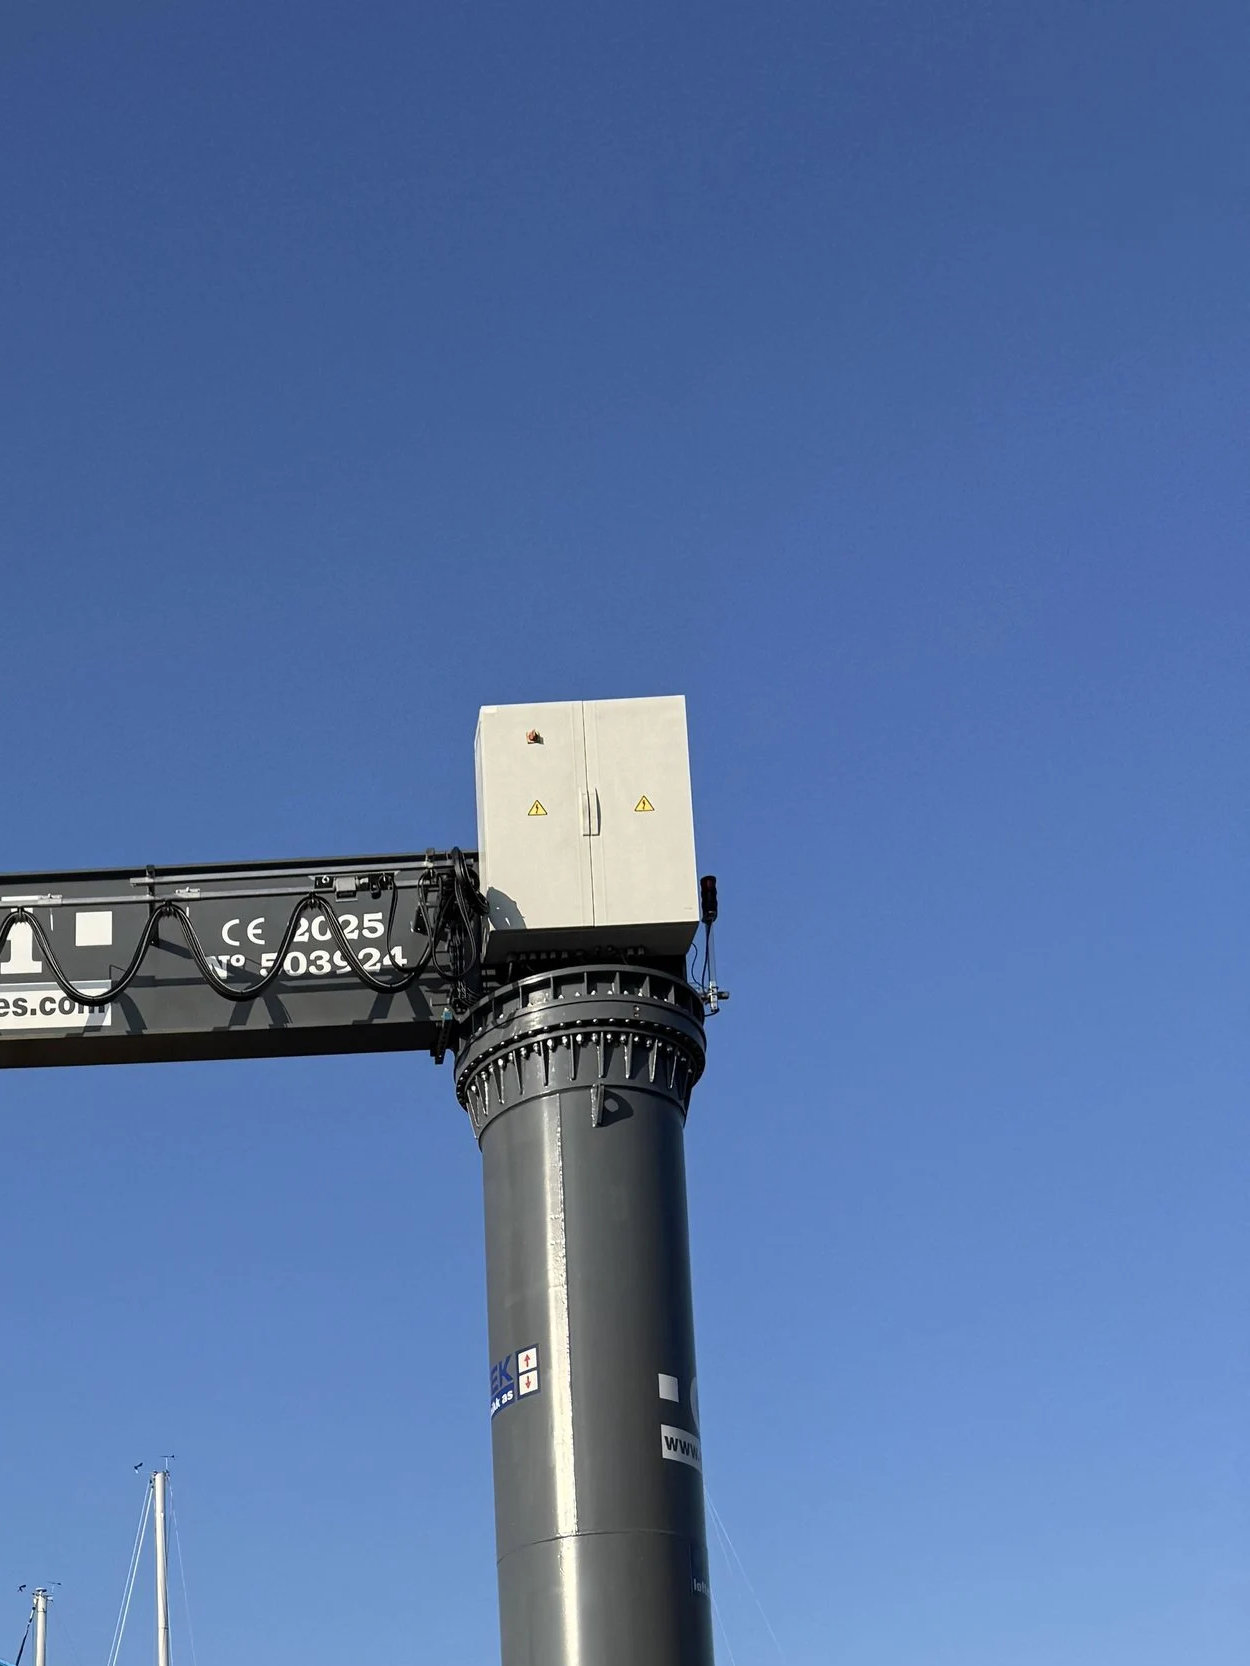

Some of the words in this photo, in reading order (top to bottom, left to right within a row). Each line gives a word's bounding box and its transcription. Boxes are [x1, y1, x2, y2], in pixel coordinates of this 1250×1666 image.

[293, 912, 385, 942] 2025
[259, 945, 408, 977] 503924
[501, 1390, 514, 1405] as
